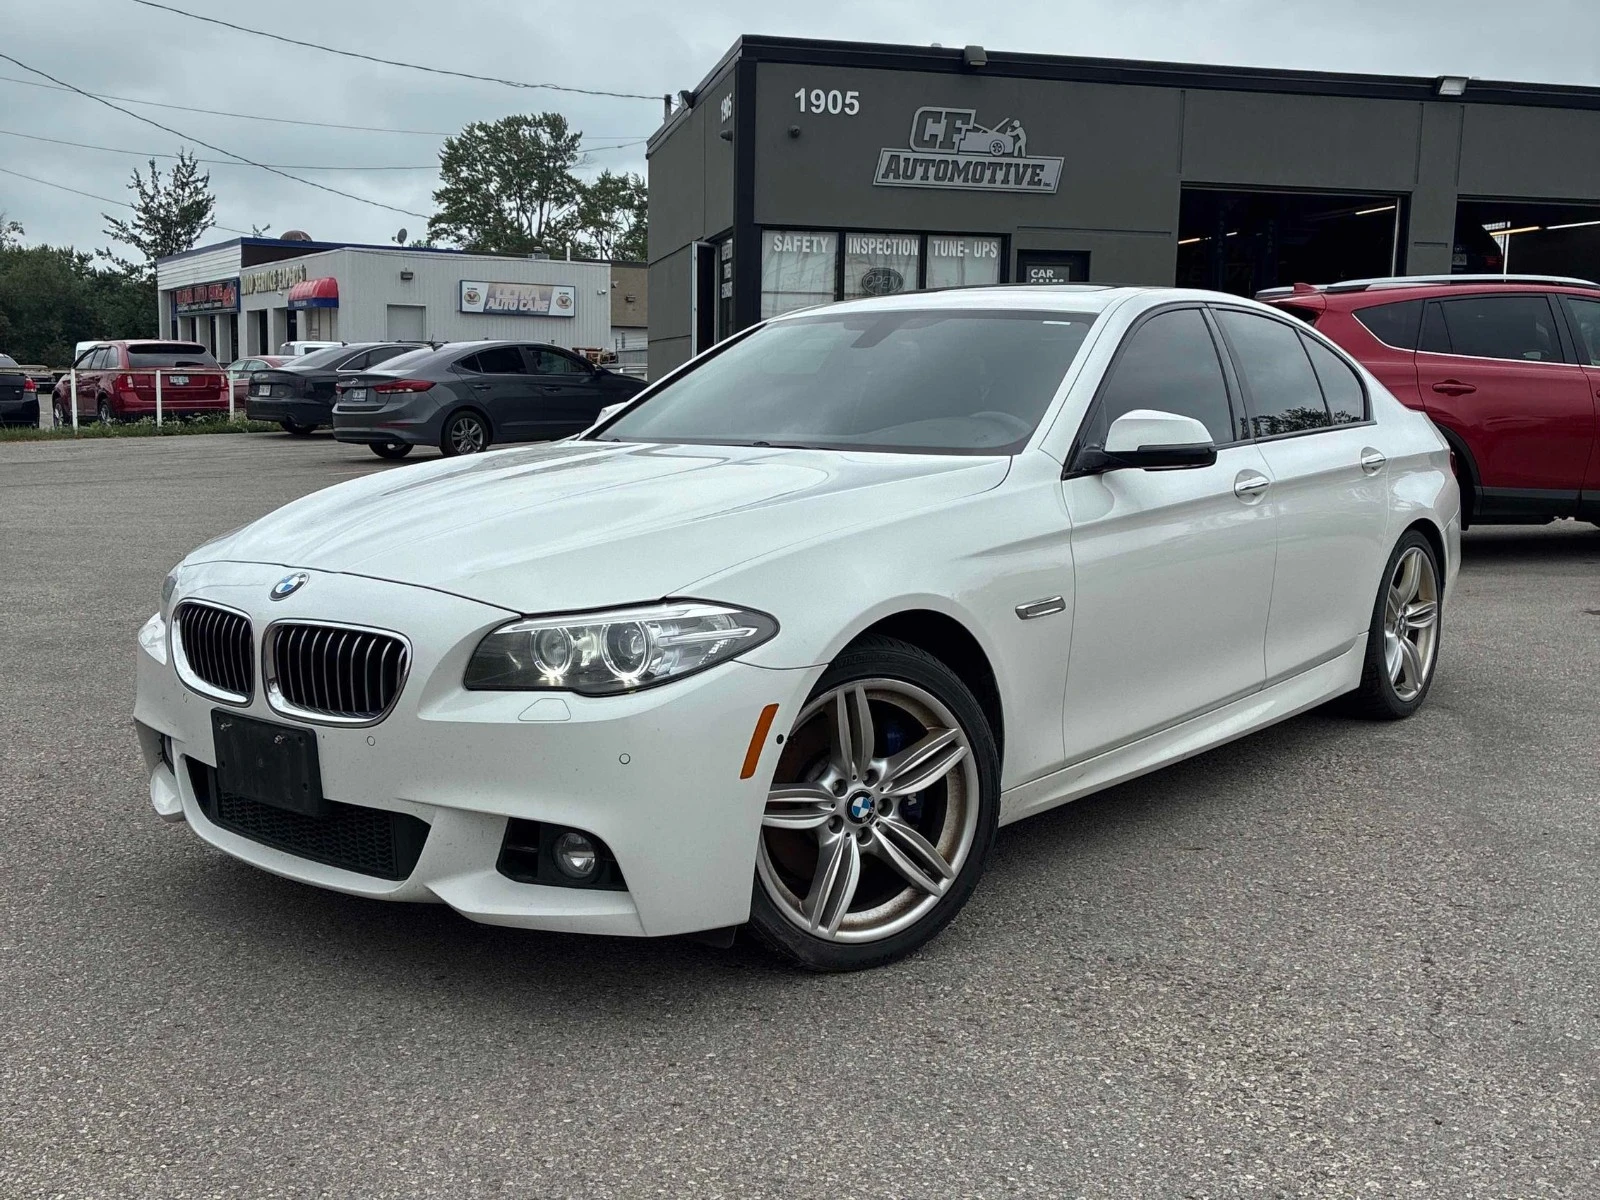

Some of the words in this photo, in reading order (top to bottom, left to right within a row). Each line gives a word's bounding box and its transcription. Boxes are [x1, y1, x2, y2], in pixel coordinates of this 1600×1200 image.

[794, 88, 860, 116] 1905
[911, 107, 975, 152] CF
[882, 154, 1045, 187] AUTOMOTIVE
[773, 236, 829, 254] SAFETY
[848, 237, 919, 256] INSPECTION
[974, 241, 998, 258] UPS
[865, 273, 900, 289] OPEN
[1030, 269, 1054, 278] CAR
[486, 296, 519, 311] AUTO
[518, 297, 551, 312] CARE
